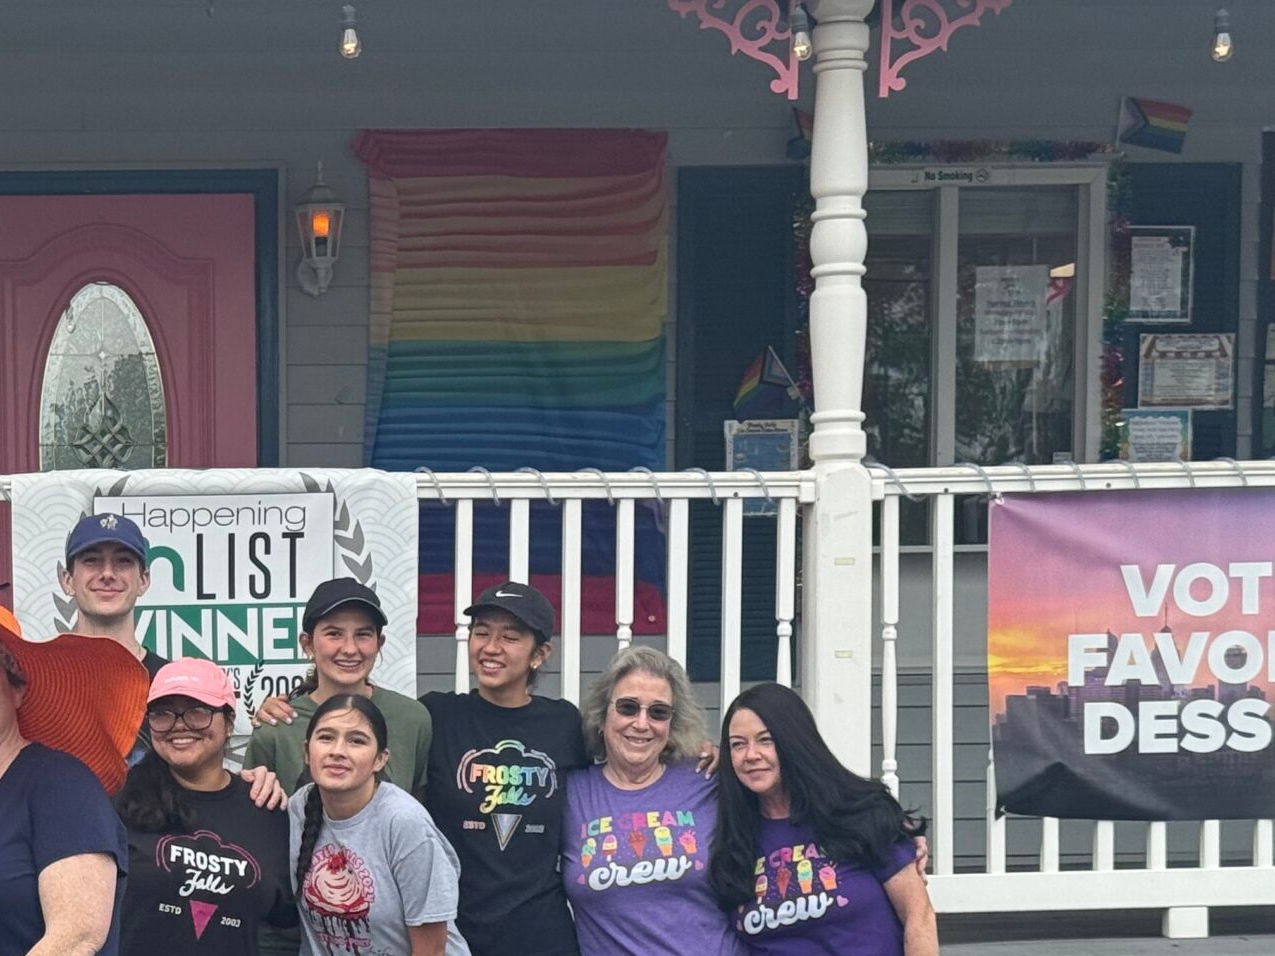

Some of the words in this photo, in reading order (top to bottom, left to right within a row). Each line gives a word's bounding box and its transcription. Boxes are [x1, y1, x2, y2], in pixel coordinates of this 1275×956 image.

[937, 170, 973, 183] Smoking
[122, 500, 307, 533] Happening
[196, 531, 305, 601] LIST
[134, 606, 307, 662] INNE
[1083, 697, 1273, 755] DESS
[469, 762, 549, 787] FROSTY
[478, 784, 537, 814] Falls
[462, 820, 486, 830] ESTD
[580, 815, 613, 840] ICE
[618, 810, 695, 830] CREAM
[170, 844, 248, 877] FROSTY
[587, 854, 693, 891] crew
[178, 868, 235, 897] Falls
[158, 902, 182, 915] ESTD
[743, 891, 834, 935] crew
